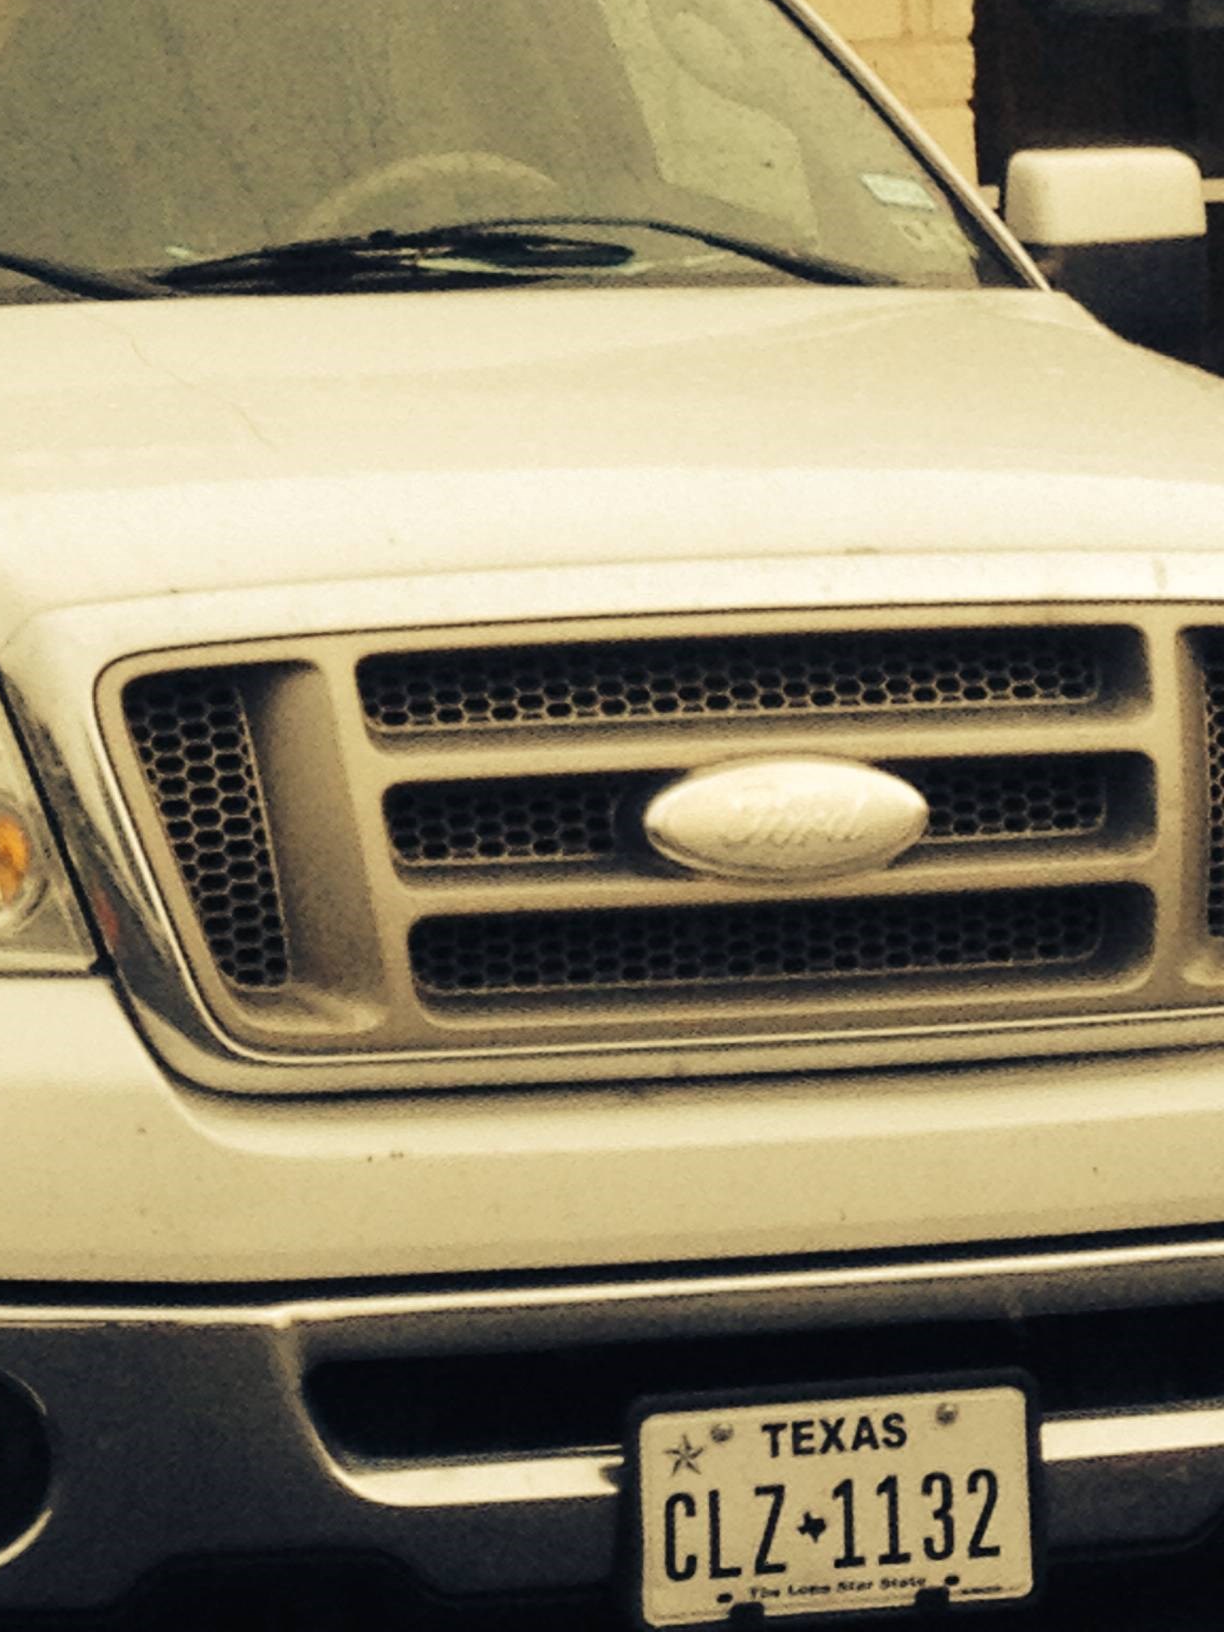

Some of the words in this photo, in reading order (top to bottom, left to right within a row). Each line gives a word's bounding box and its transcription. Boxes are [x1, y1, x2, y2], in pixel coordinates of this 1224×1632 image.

[762, 1412, 908, 1459] TEXAS
[750, 1585, 781, 1600] The
[879, 1575, 927, 1590] State
